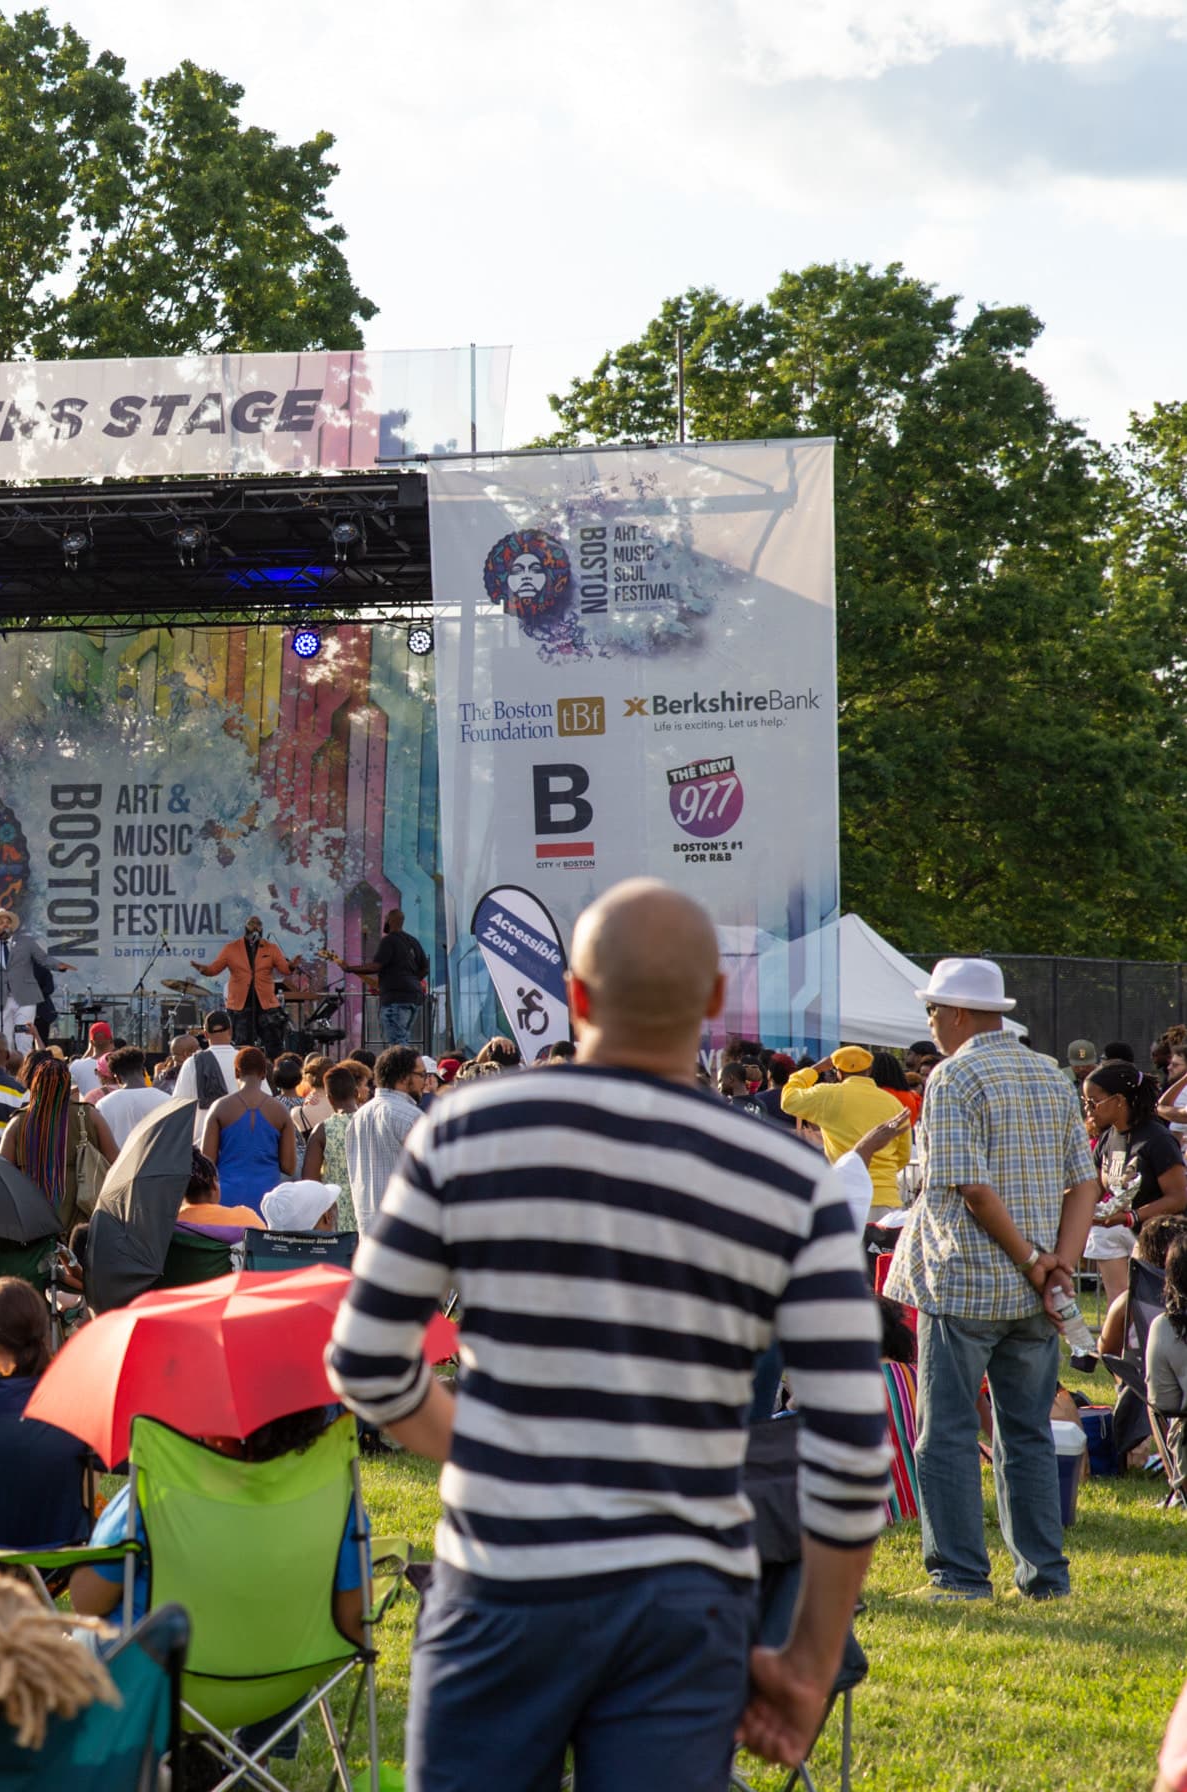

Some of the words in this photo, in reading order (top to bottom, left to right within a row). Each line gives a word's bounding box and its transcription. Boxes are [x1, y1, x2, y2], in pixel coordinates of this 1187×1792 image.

[102, 388, 324, 438] STAGE
[614, 525, 638, 542] ART
[614, 544, 654, 563] MUSIC
[580, 526, 608, 614] BOSTON
[614, 565, 647, 582] SOUL
[614, 583, 674, 602] FESTIVAL
[459, 703, 491, 722] The
[494, 701, 553, 720] Boston
[652, 688, 821, 716] BerkshireBank
[562, 701, 602, 732] tBf
[654, 722, 672, 732] Life
[674, 721, 682, 731] is
[684, 719, 726, 731] exciting.
[728, 718, 744, 729] Let
[747, 719, 758, 728] us
[460, 720, 554, 743] Foundation
[669, 766, 697, 783] THE
[698, 758, 733, 776] NEW
[116, 784, 163, 815] ART
[167, 783, 191, 814] &
[533, 763, 594, 836] B
[676, 776, 738, 825] 97.7
[113, 823, 194, 857] MUSIC
[673, 841, 728, 853] BOSTON'S
[730, 840, 743, 851] #1
[47, 783, 102, 957] BOSTON
[536, 861, 554, 869] CITY
[563, 859, 596, 868] BOSTON
[684, 853, 707, 863] FOR
[709, 852, 732, 862] R&B
[112, 864, 177, 897] SOUL
[112, 903, 229, 937] FESTIVAL
[114, 946, 206, 958] bamsfest.org
[482, 926, 518, 957] Zone
[489, 912, 562, 966] Accessible
